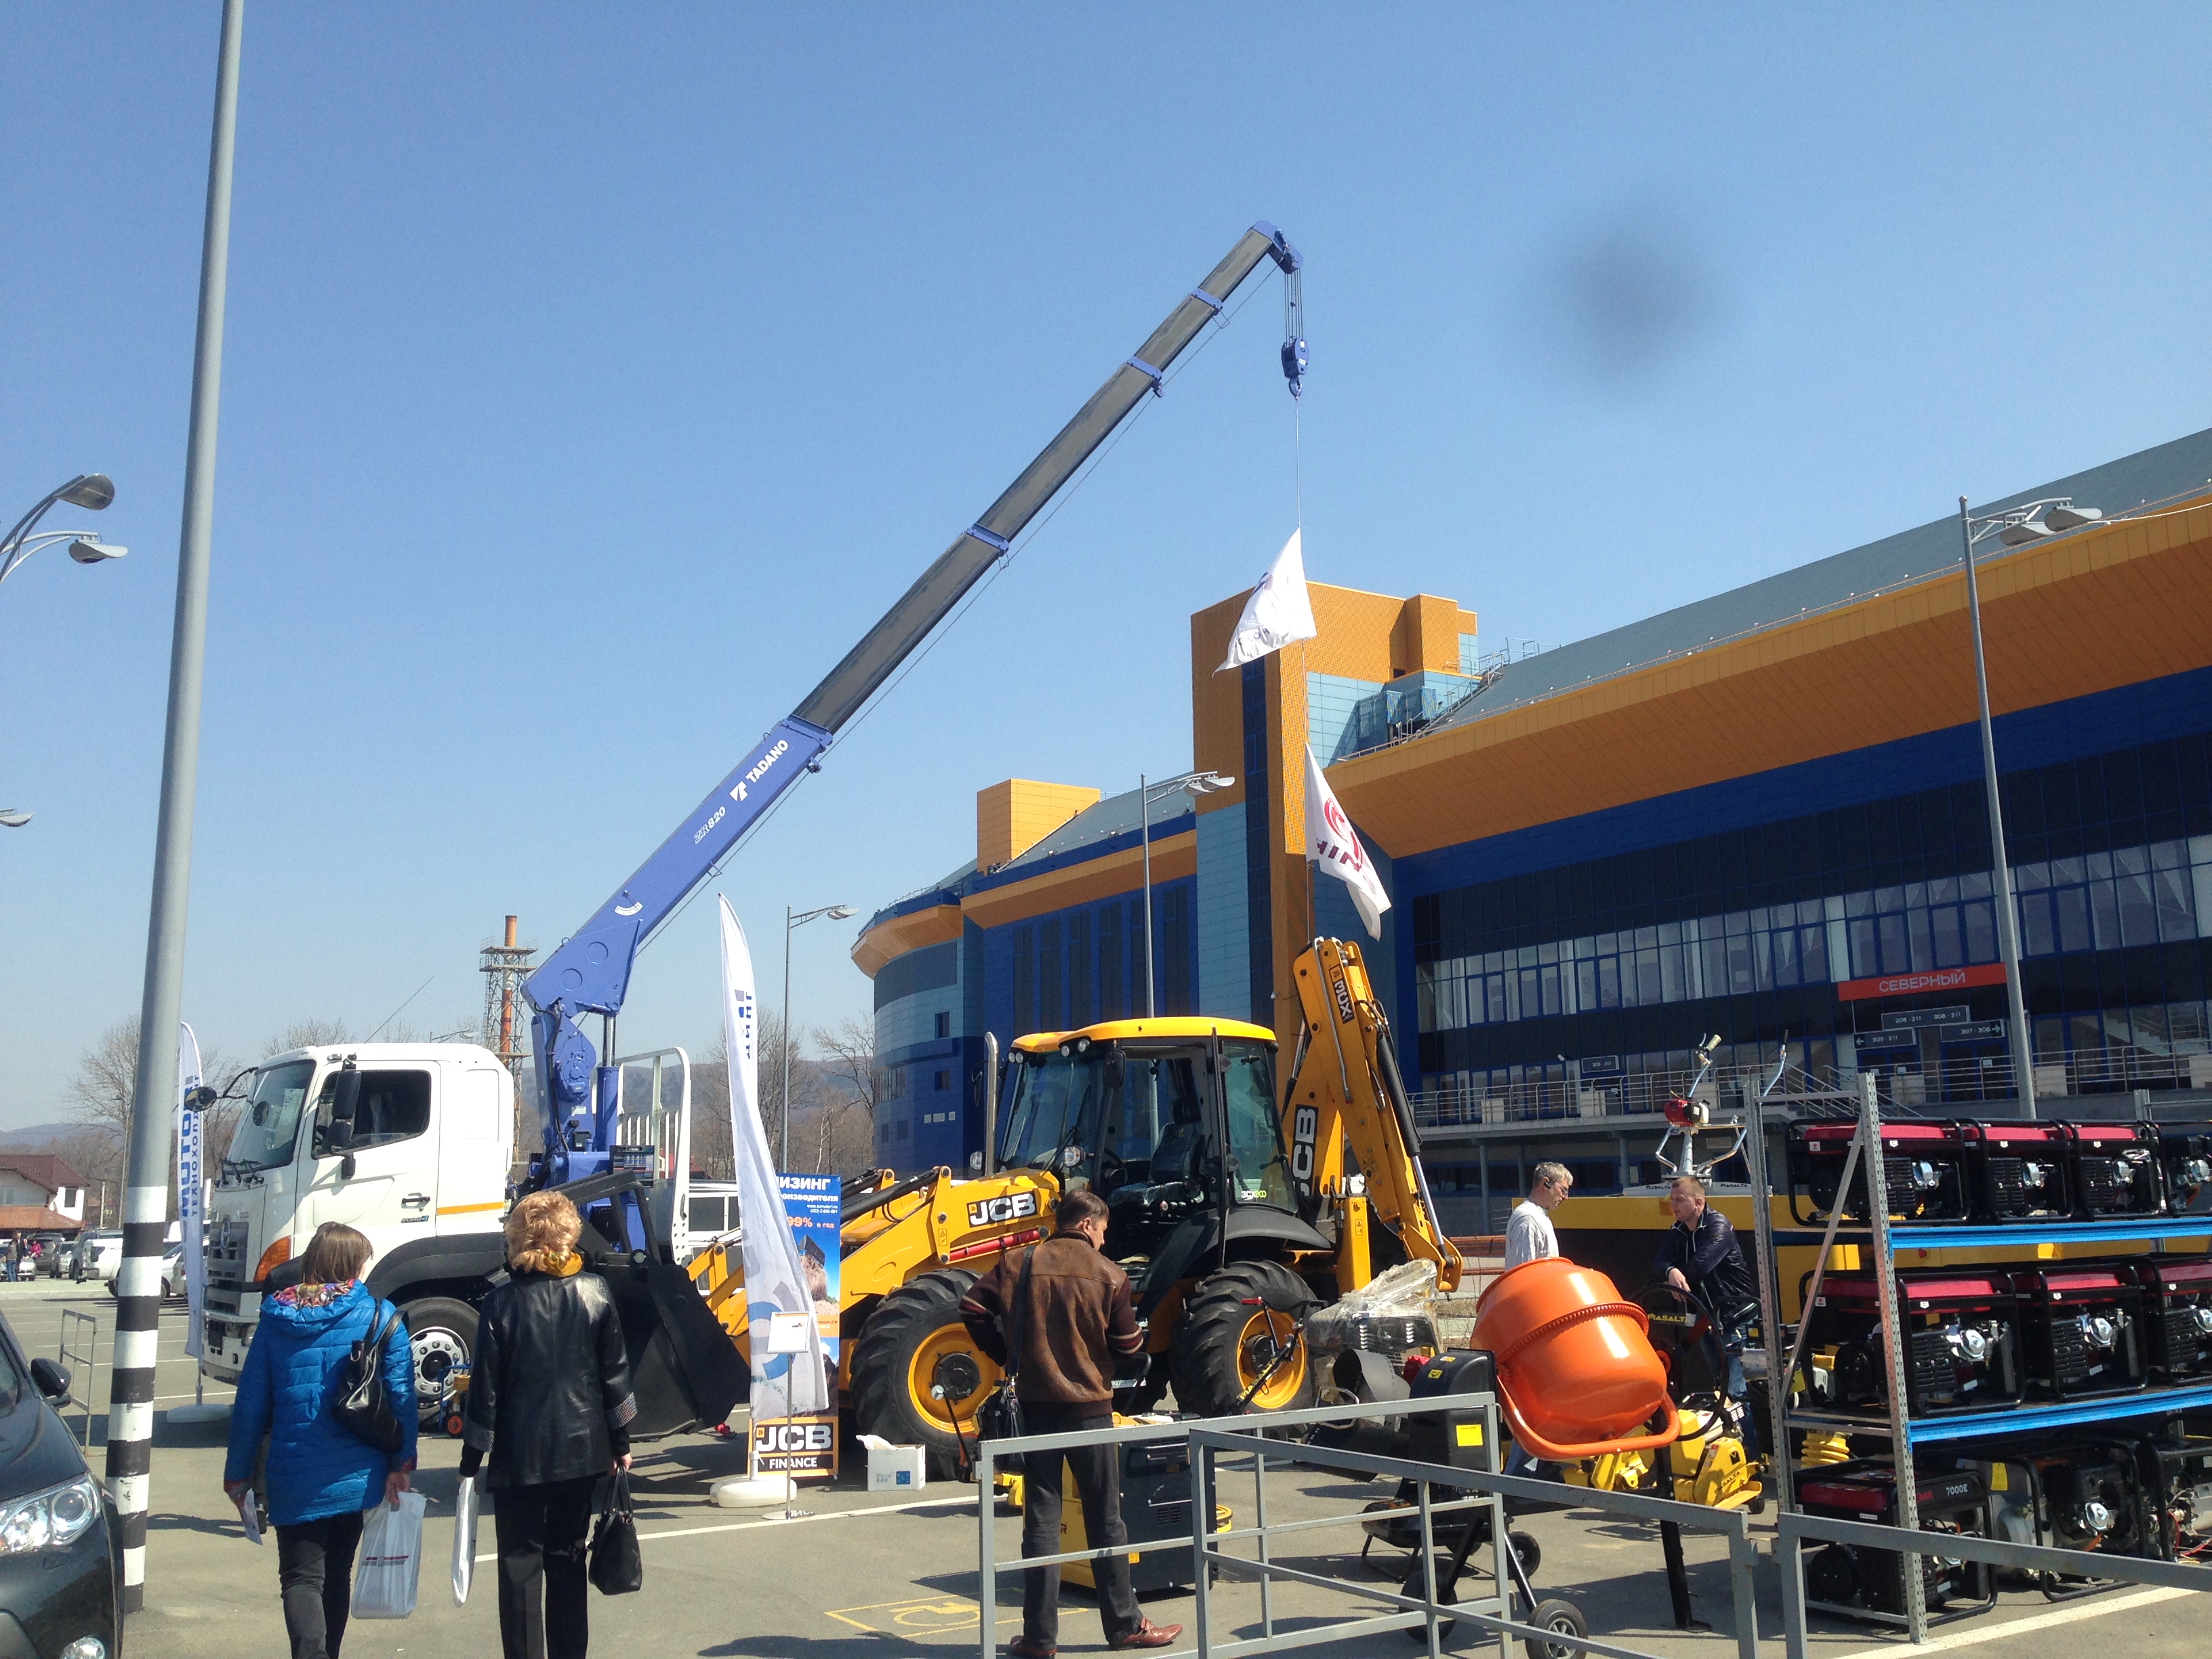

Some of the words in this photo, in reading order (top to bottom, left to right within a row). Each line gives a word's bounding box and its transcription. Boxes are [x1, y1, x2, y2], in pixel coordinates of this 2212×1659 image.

[745, 739, 789, 783] TADANO
[693, 806, 726, 844] ZR820
[1879, 968, 1966, 993] СЕВЕРНЫЙ
[1334, 980, 1352, 1017] 3CX
[781, 1193, 838, 1202] оизводителя
[970, 1193, 1036, 1225] JCB
[756, 1425, 831, 1451] JCB
[769, 1457, 817, 1469] FINANCE
[1946, 1483, 1968, 1496] 7000E
